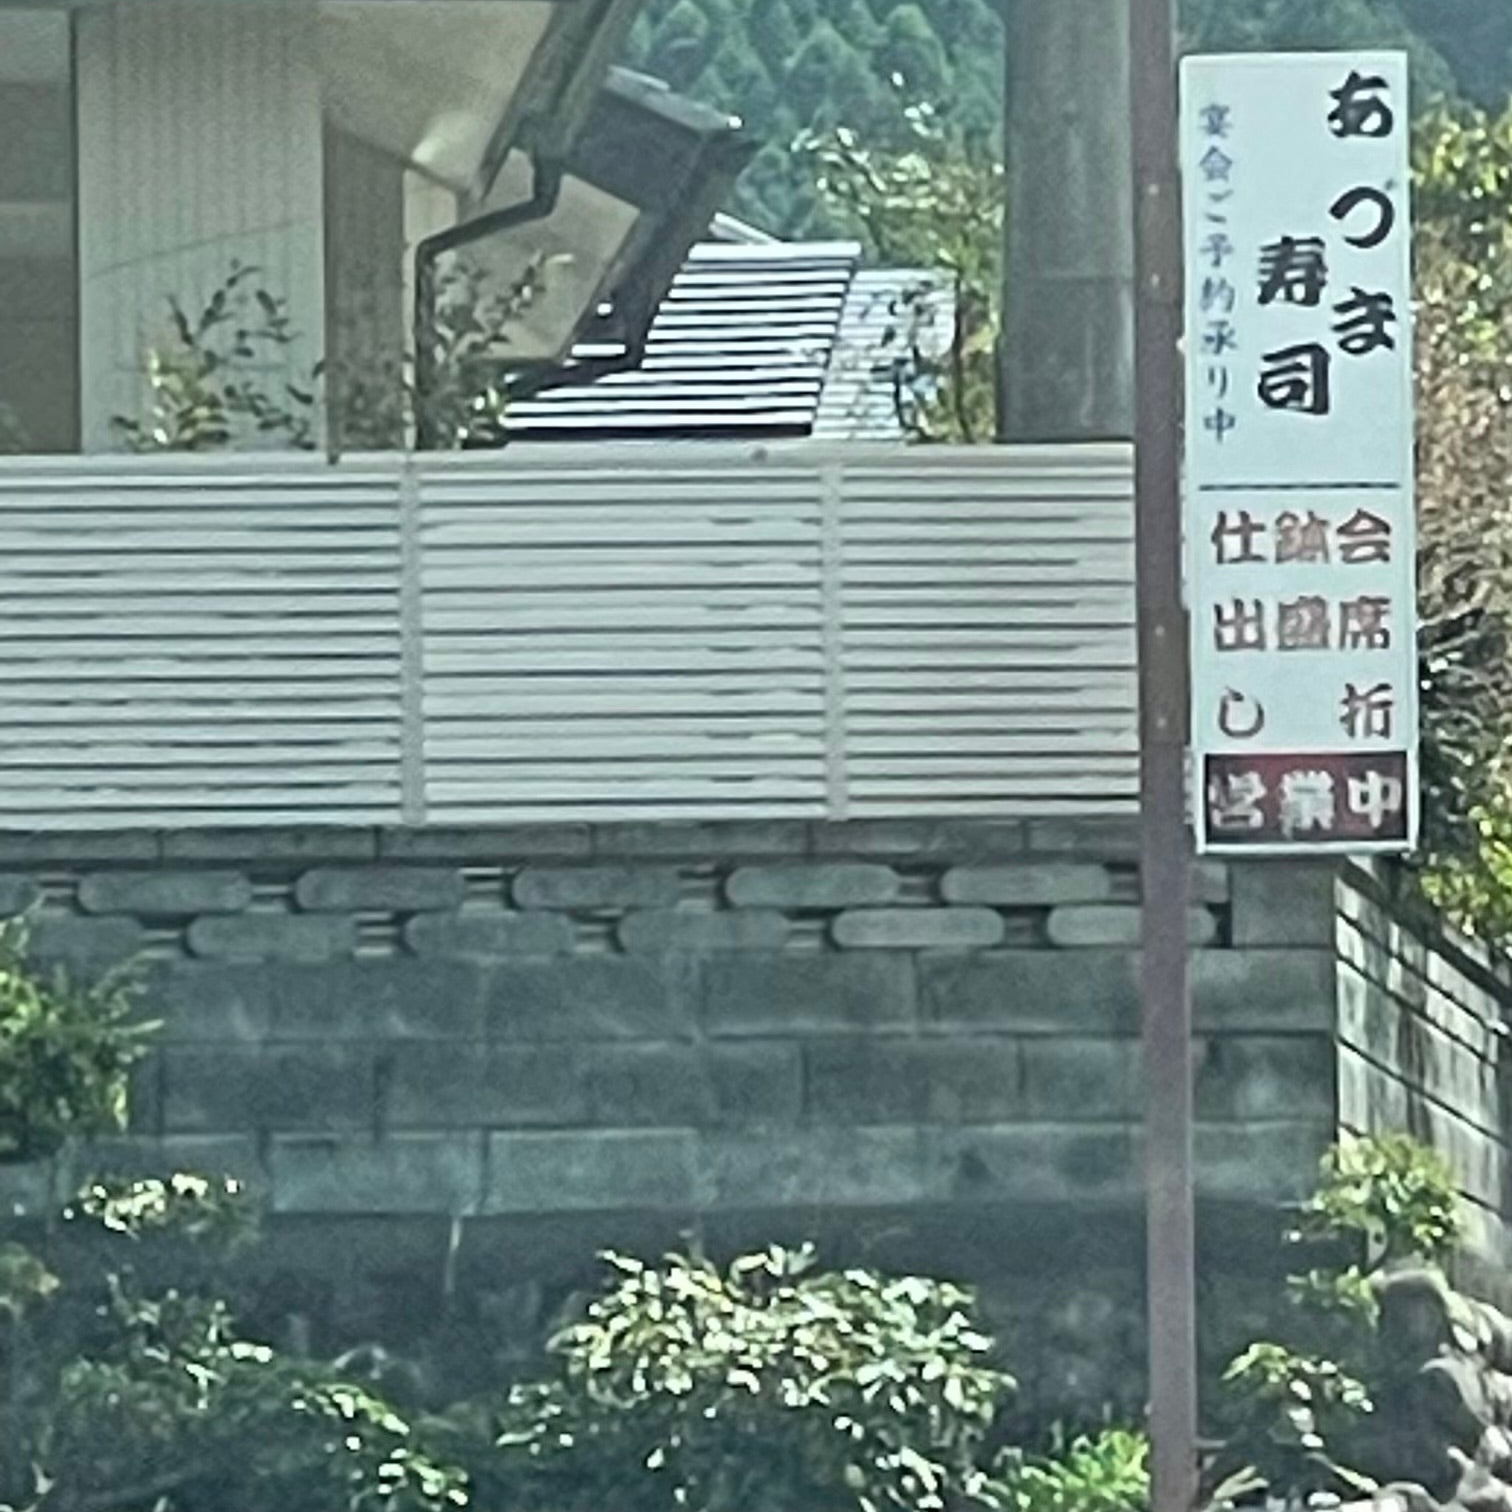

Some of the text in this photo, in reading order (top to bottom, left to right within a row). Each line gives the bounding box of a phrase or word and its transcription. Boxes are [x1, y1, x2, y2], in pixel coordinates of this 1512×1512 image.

[1198, 102, 1238, 444] 宴会ご予約承り中
[1257, 235, 1330, 416] 寿司
[1211, 510, 1268, 738] 仕出し
[1336, 508, 1394, 739] 会席折
[1208, 769, 1402, 838] 営業中
